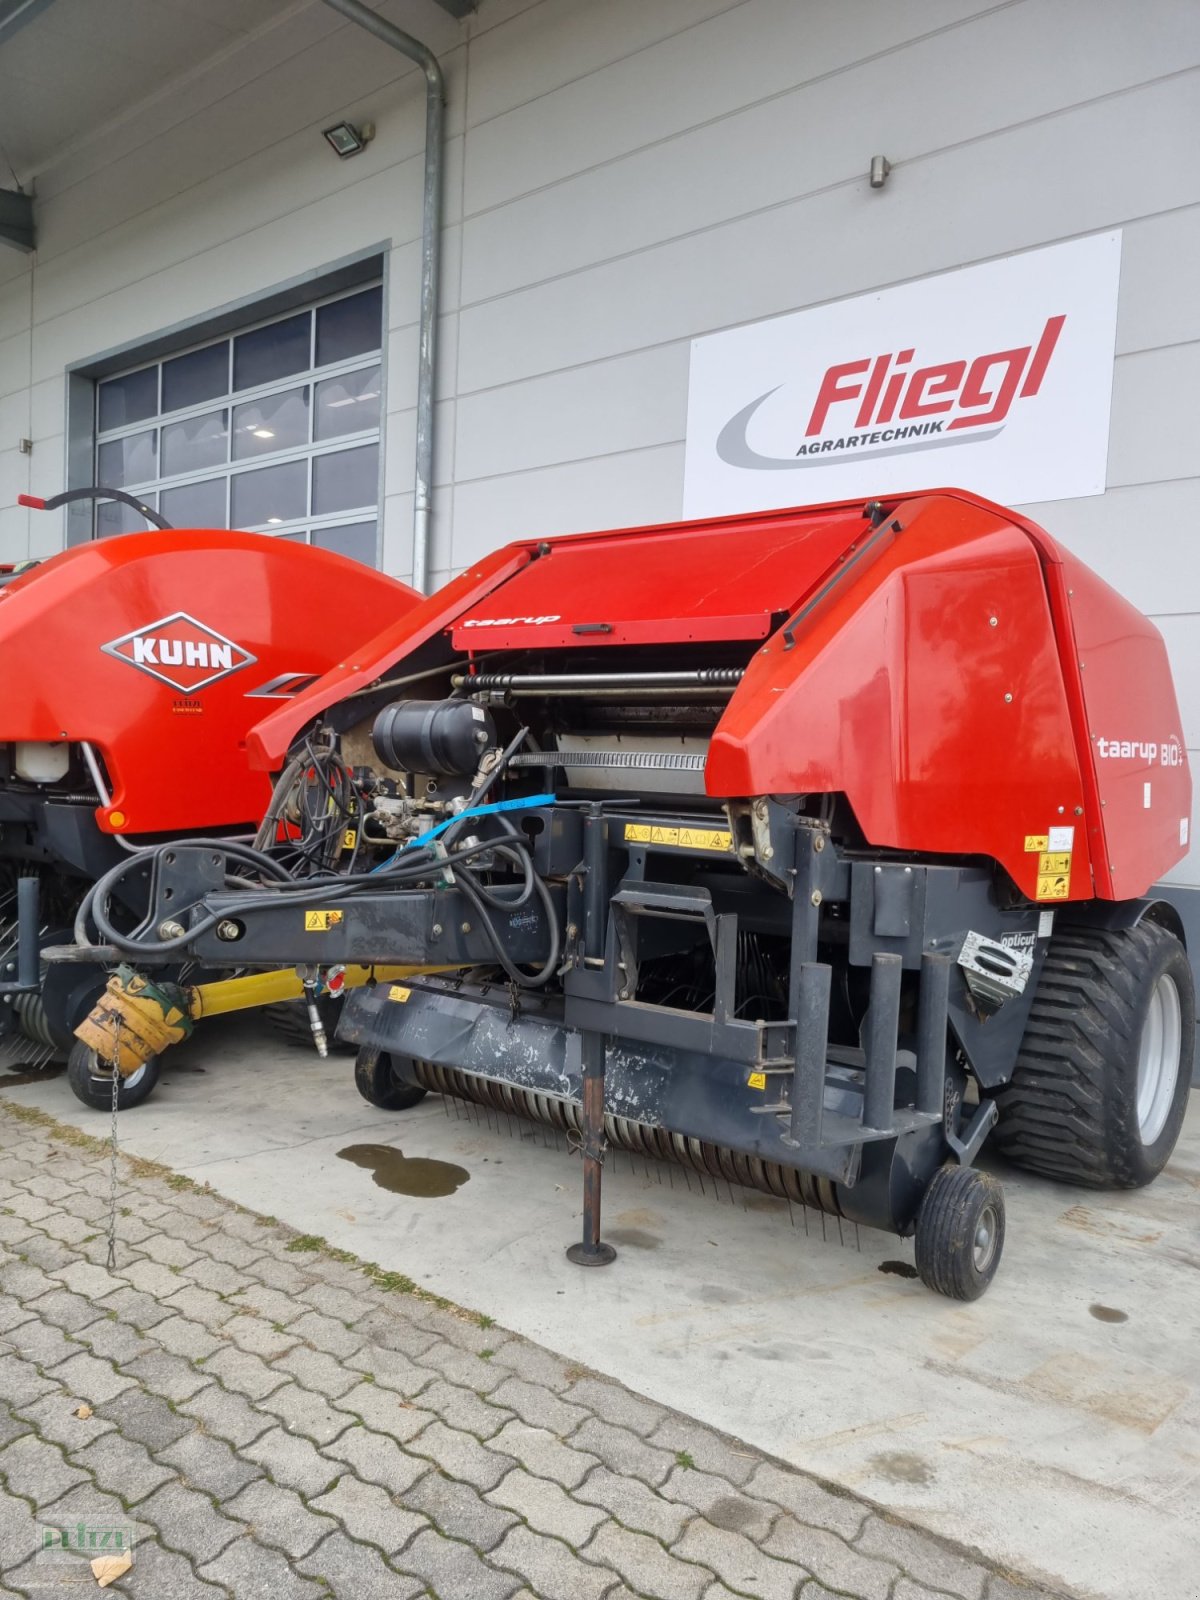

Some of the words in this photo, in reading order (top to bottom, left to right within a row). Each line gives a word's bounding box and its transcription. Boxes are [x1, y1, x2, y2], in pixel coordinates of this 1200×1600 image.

[804, 314, 1067, 437] Fliegl
[795, 420, 945, 456] AGRARTECHNIK
[463, 615, 561, 628] taarup
[133, 637, 233, 669] KUHN
[1097, 737, 1158, 765] taarup
[1001, 933, 1035, 948] opticut
